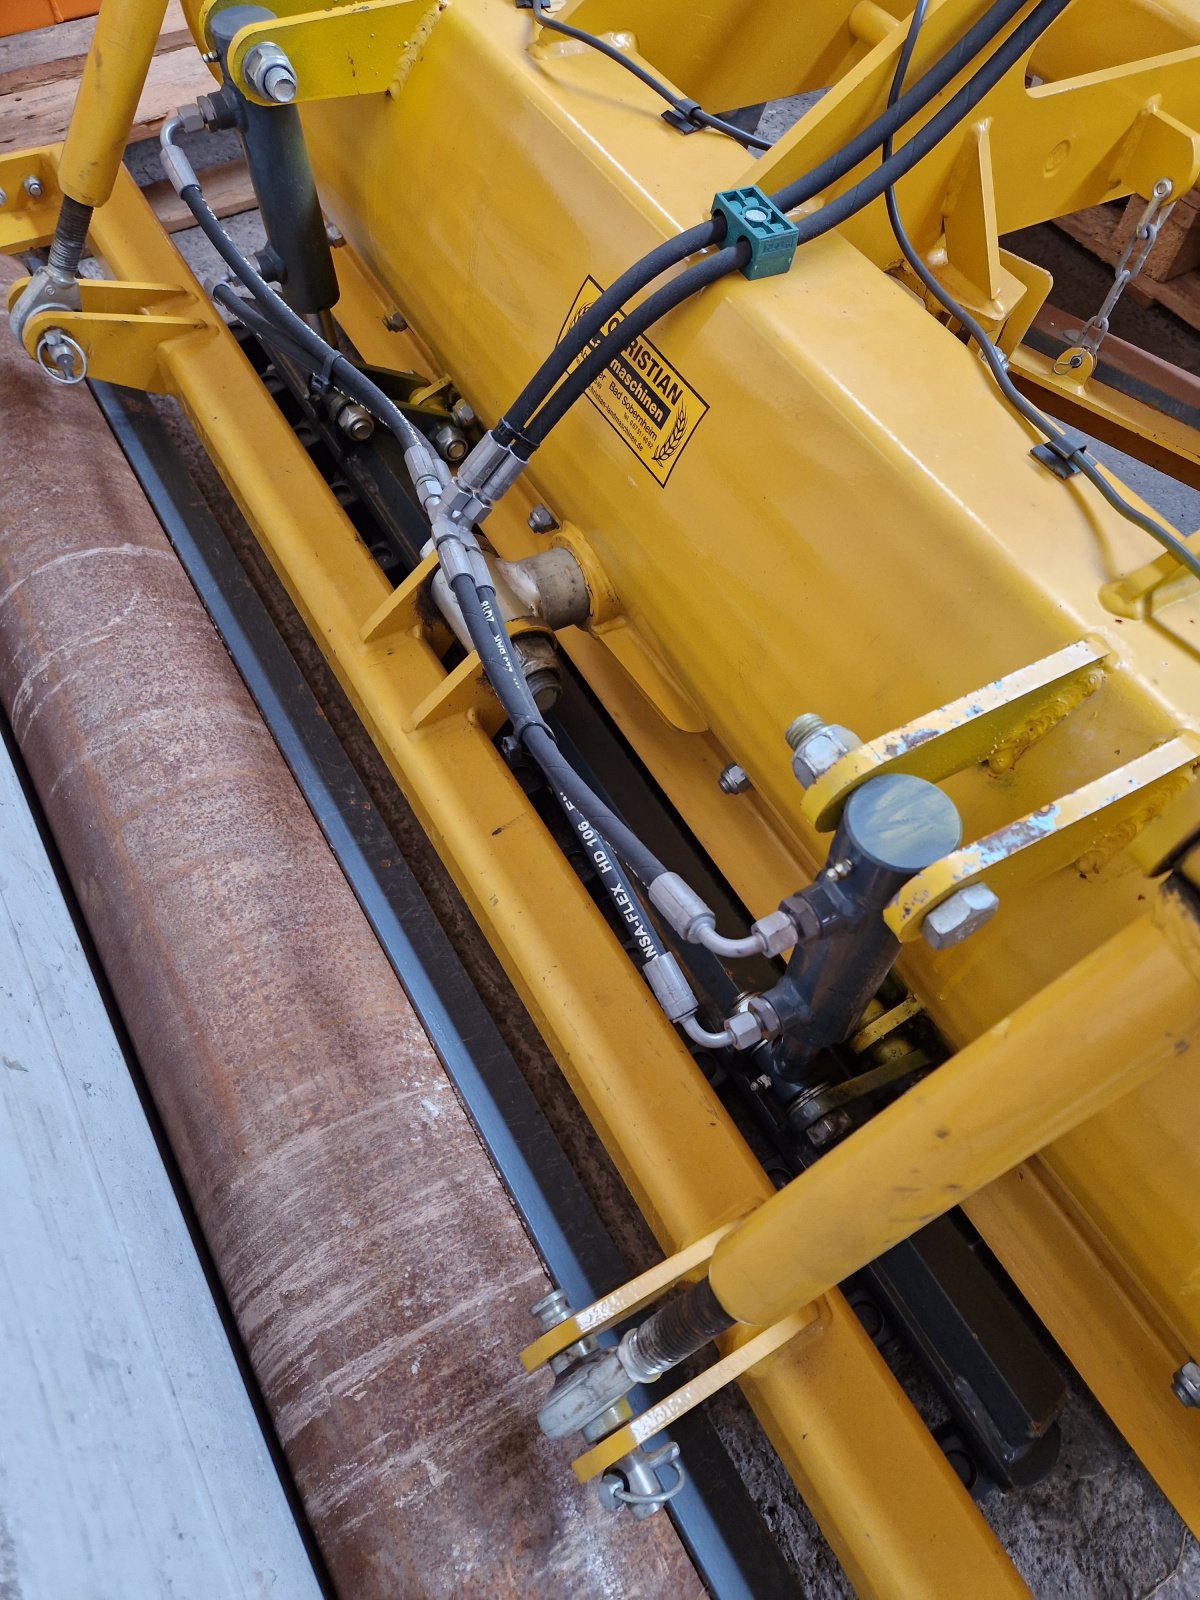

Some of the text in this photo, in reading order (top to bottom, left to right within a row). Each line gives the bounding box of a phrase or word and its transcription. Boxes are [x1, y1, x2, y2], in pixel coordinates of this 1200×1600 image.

[608, 317, 683, 406] CRISTIAN
[609, 381, 658, 442] Bad Sobernheim
[578, 820, 659, 961] NSA-FLEX HD 106
